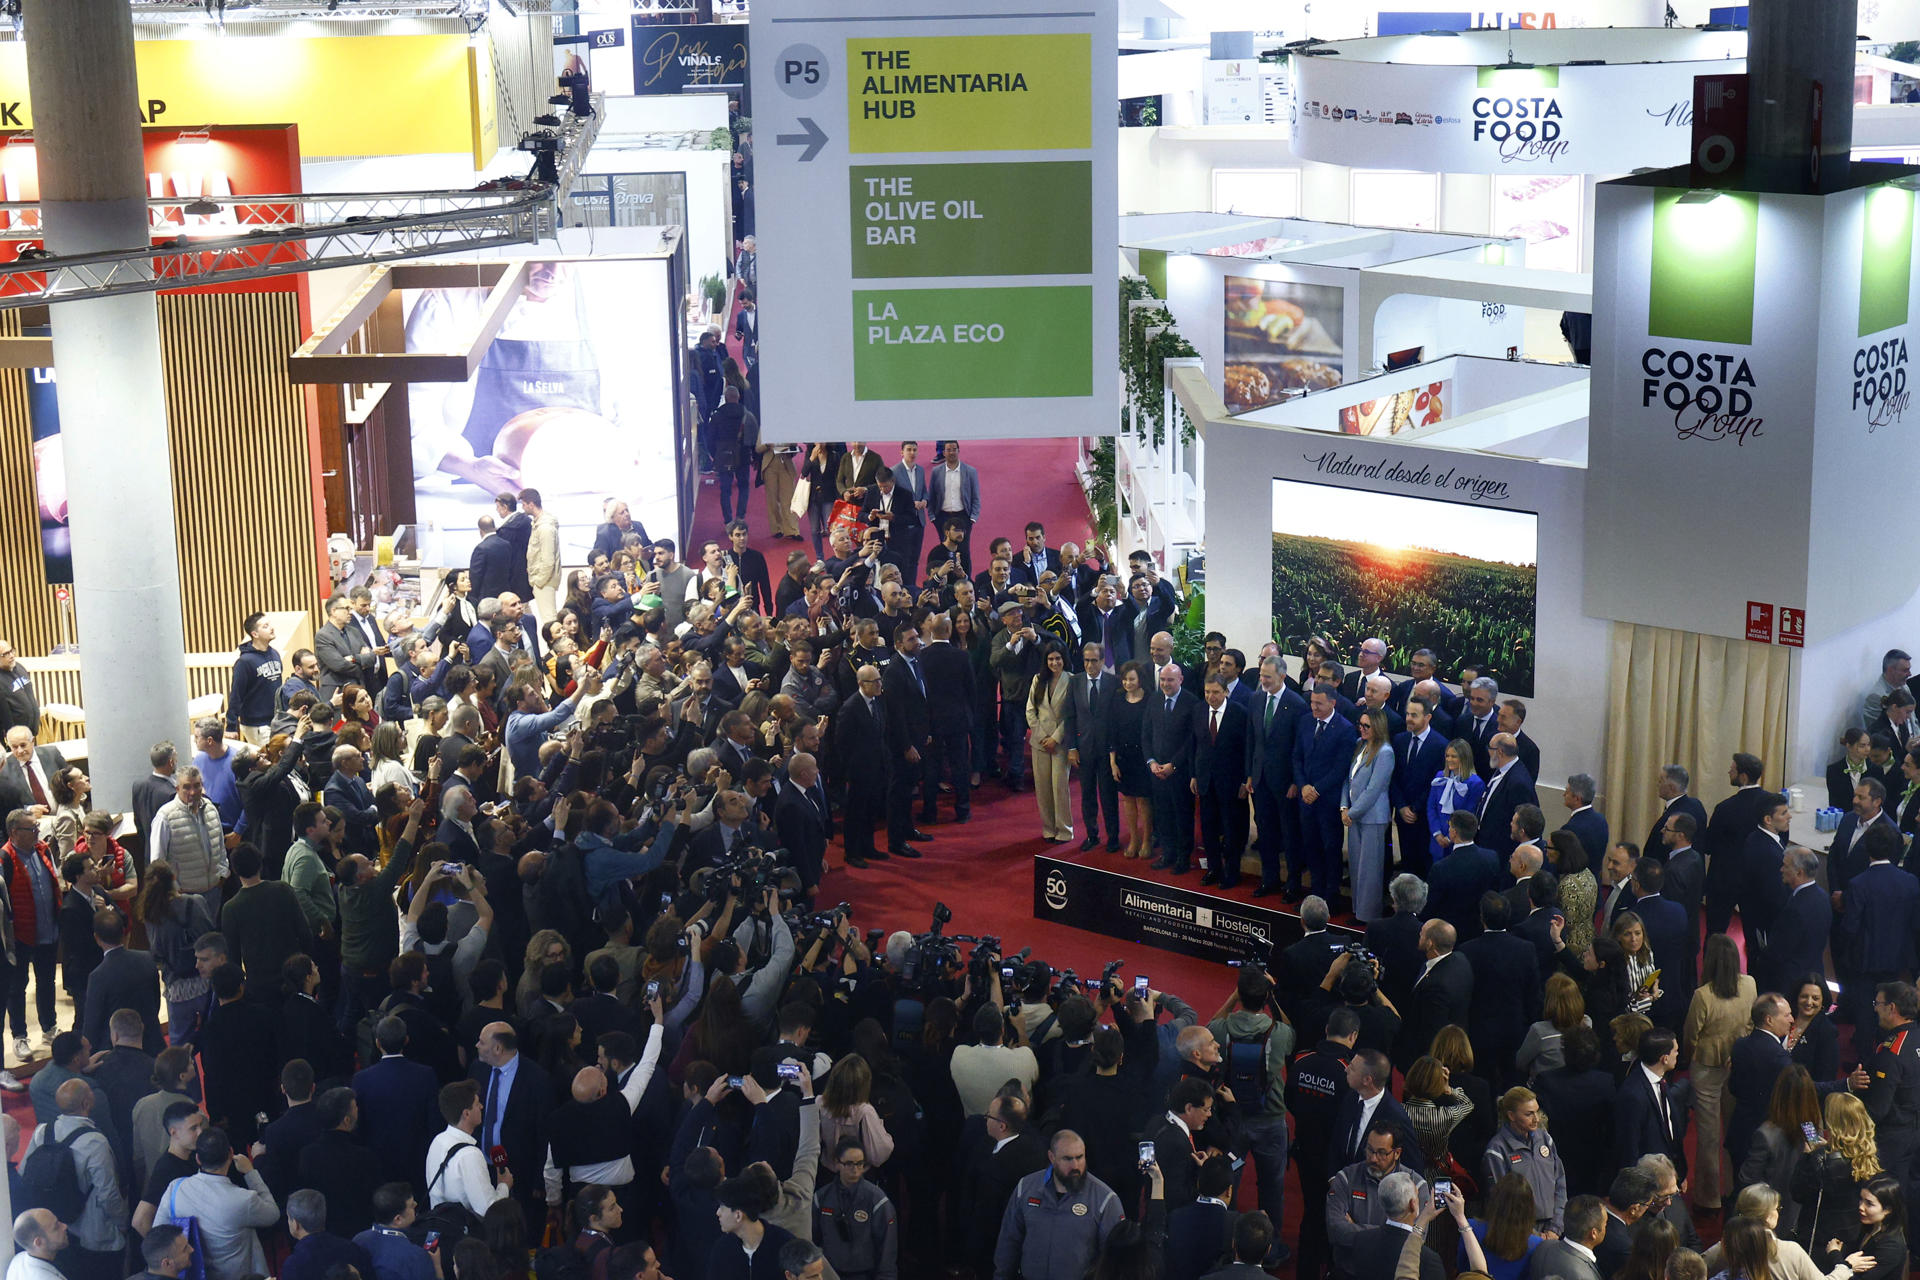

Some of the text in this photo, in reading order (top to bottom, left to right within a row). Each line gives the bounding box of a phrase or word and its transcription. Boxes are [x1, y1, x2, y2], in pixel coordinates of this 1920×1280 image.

[678, 52, 722, 67] VIÑALS
[862, 51, 910, 70] THE
[785, 61, 820, 84] P5
[862, 73, 1028, 95] ALIMENTARIA
[864, 100, 916, 119] HUB
[1472, 97, 1563, 119] COSTA
[1474, 120, 1561, 142] FOOD
[1499, 130, 1570, 163] Group
[864, 177, 913, 197] THE
[614, 192, 654, 205] Brava
[865, 200, 983, 221] OLIVE OIL
[866, 225, 916, 246] BAR
[868, 302, 898, 321] LA
[1482, 304, 1505, 318] FOOD
[868, 324, 1005, 345] PLAZA ECO
[1642, 348, 1756, 387] COSTA
[1853, 337, 1909, 378] COSTA
[1643, 379, 1753, 417] FOOD
[1852, 367, 1907, 411] FOOD
[1867, 386, 1911, 433] Group
[1675, 398, 1764, 446] Group
[1303, 451, 1510, 500] Natural desde el origen
[1046, 877, 1067, 896] 50
[1125, 893, 1193, 920] Alimentaria
[1216, 914, 1266, 938] Hostelco
[1125, 910, 1146, 920] RETAIL
[1164, 919, 1207, 934] FOODSERVICE
[1143, 925, 1172, 937] BARCELONA
[1299, 1072, 1336, 1091] POLICIA
